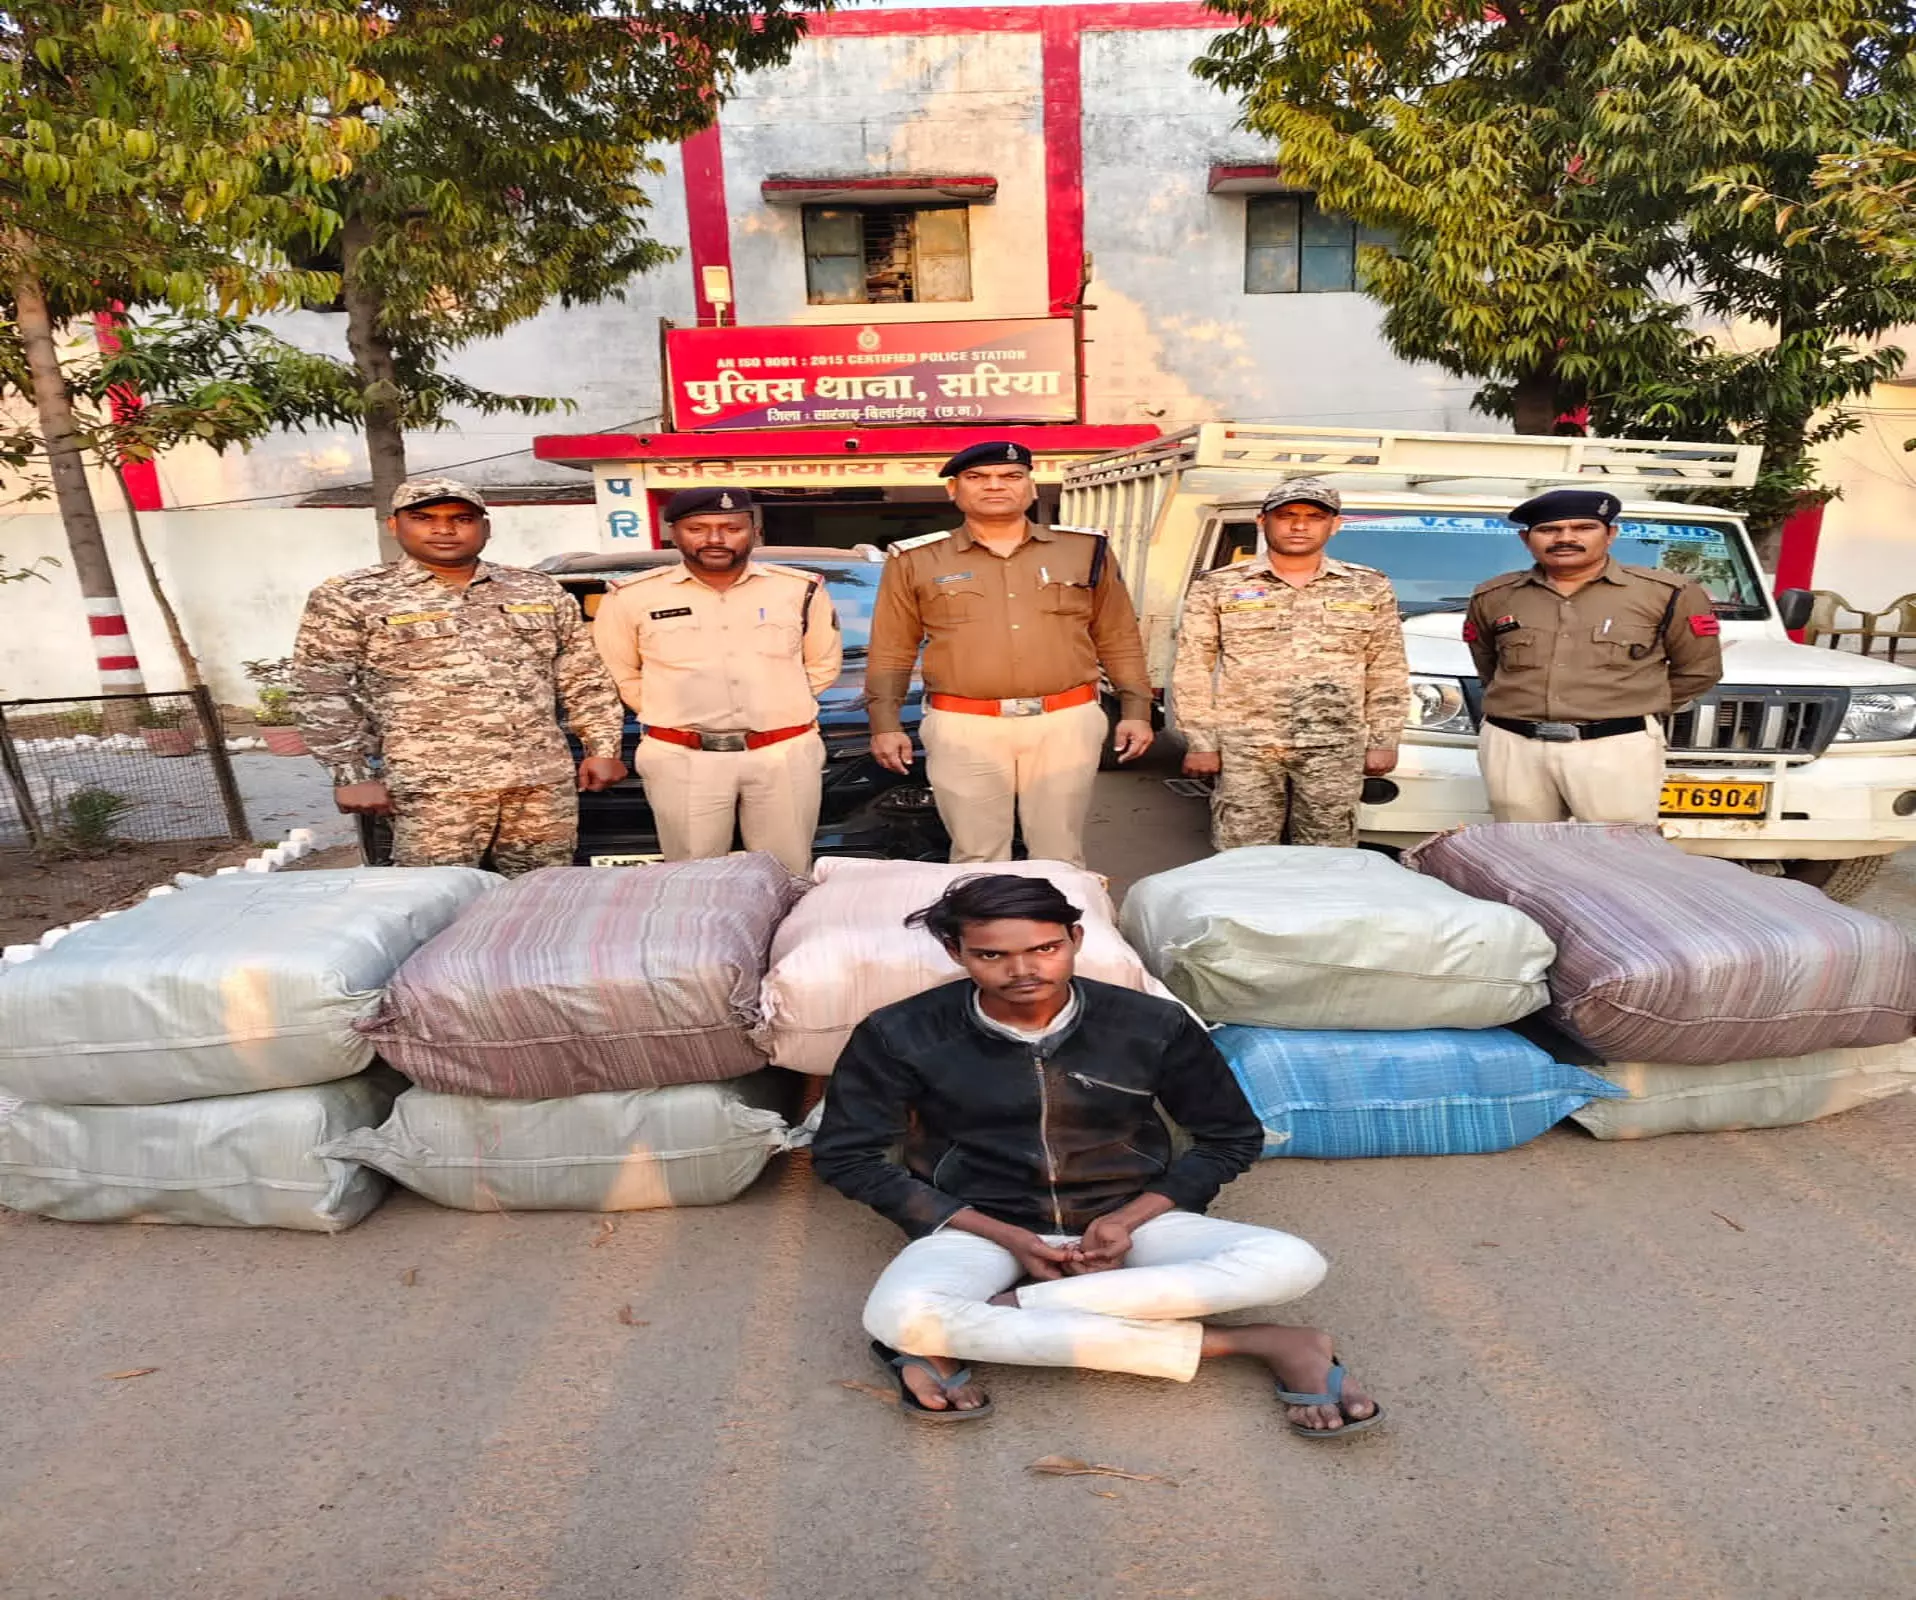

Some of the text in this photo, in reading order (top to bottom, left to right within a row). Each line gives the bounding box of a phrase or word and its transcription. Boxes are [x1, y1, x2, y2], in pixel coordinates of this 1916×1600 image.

[738, 357, 761, 368] ISO
[764, 356, 797, 367] 9001
[810, 355, 844, 366] 2015
[847, 352, 917, 366] CERTIFIED
[920, 351, 968, 362] POLICE
[971, 350, 1028, 361] STATION
[683, 362, 1061, 415] पुलिस थाना, सरिया
[766, 407, 801, 422] जिला
[603, 478, 642, 538] प रि
